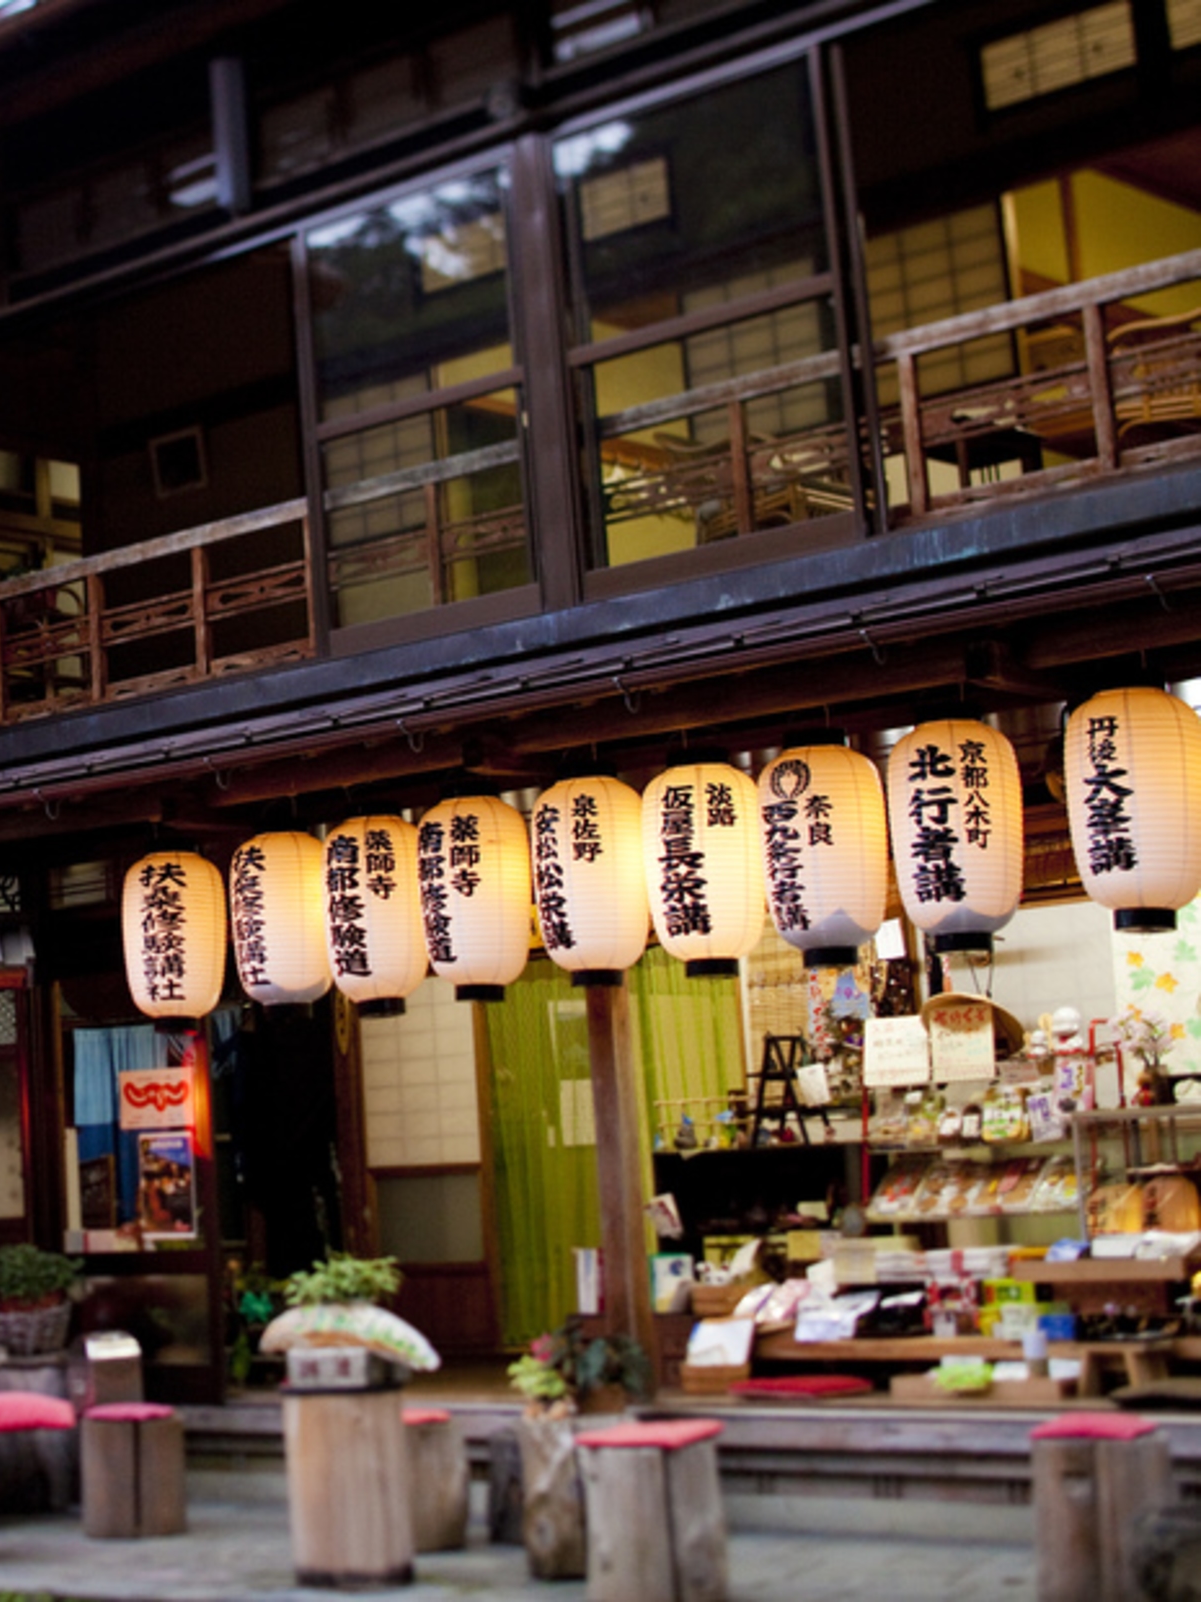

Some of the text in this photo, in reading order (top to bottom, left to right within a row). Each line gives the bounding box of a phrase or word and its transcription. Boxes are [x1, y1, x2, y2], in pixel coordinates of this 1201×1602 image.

[571, 793, 603, 863] 泉佐野
[705, 783, 737, 827] 淡路
[804, 795, 834, 845] 奈良
[909, 744, 966, 903] 北行者講
[958, 739, 991, 849] 京都八木町
[366, 829, 396, 899] 薬師寺
[449, 814, 481, 897] 薬師寺
[326, 835, 372, 978] 南都修験道
